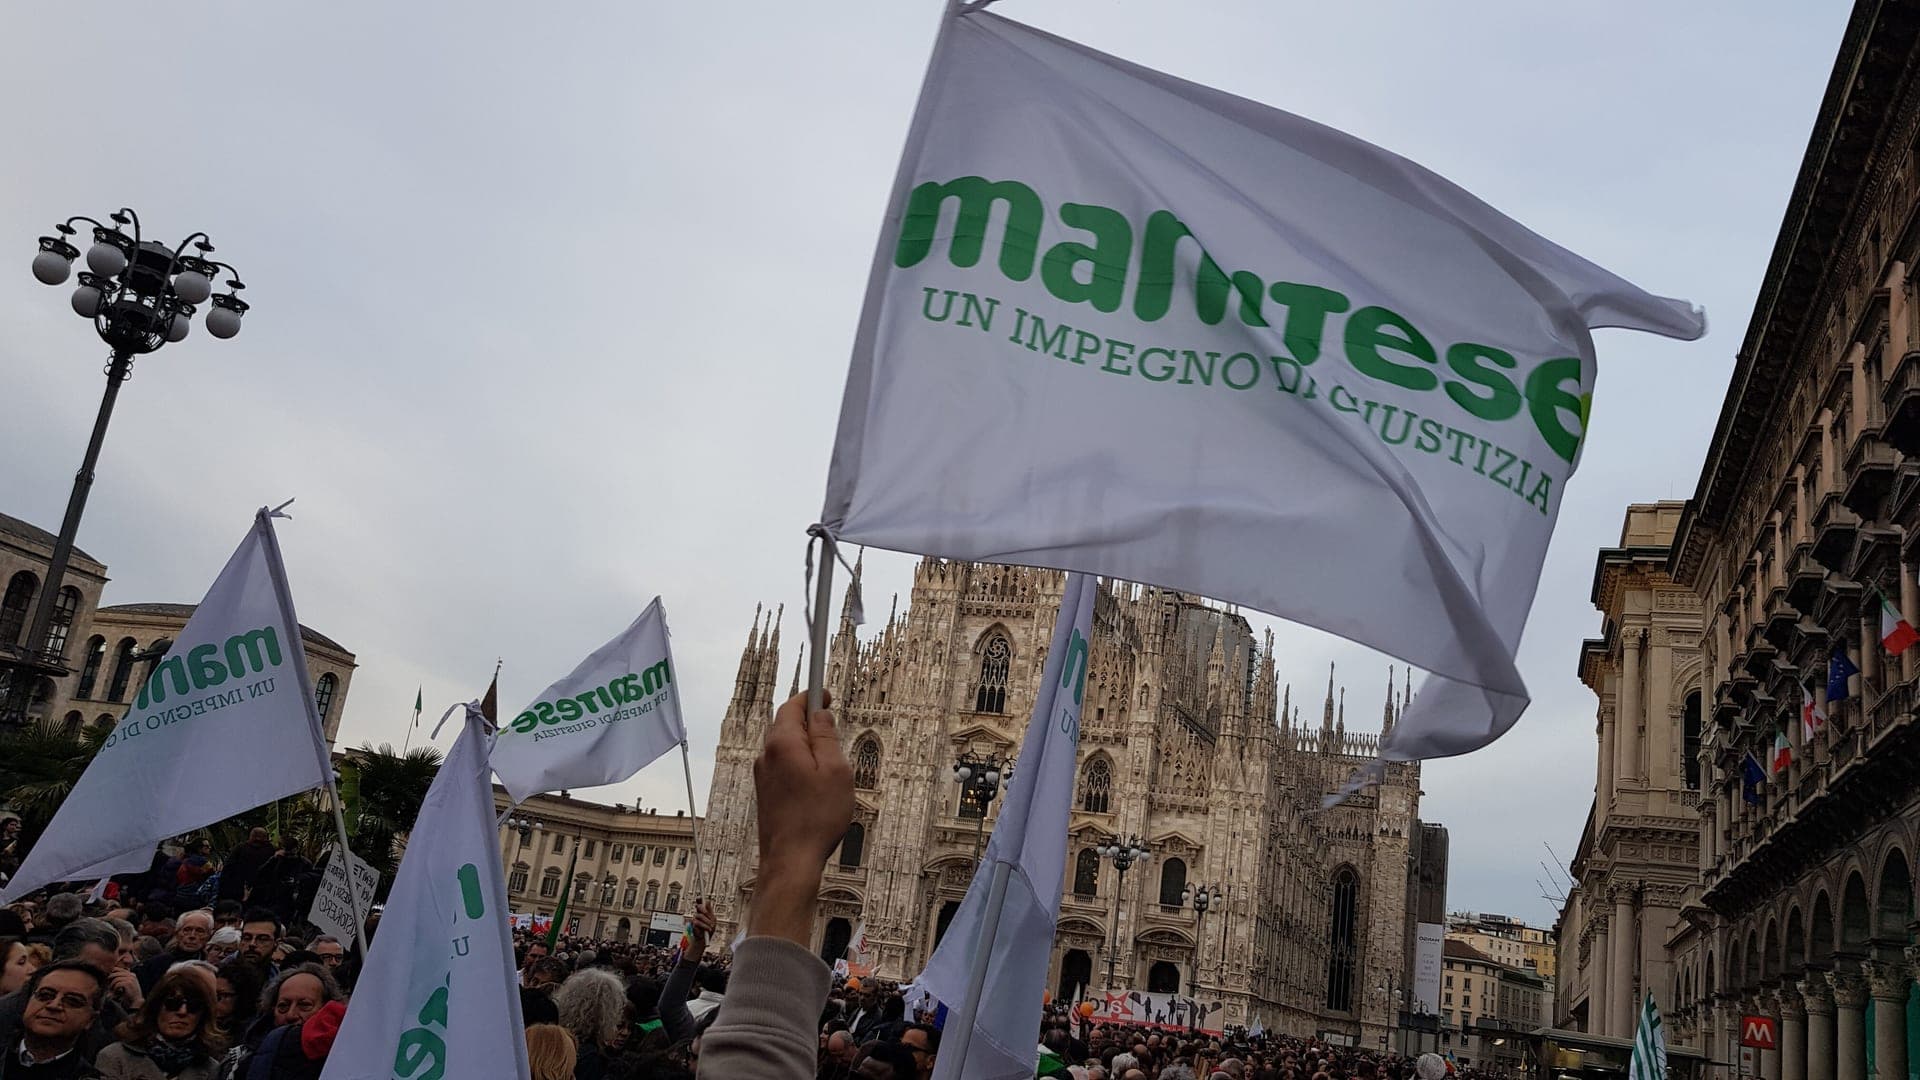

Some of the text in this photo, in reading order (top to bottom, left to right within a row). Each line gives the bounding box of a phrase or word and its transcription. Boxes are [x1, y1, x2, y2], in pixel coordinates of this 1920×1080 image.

[923, 287, 1552, 516] UN IMPEGNO DI GIUSTIZIA
